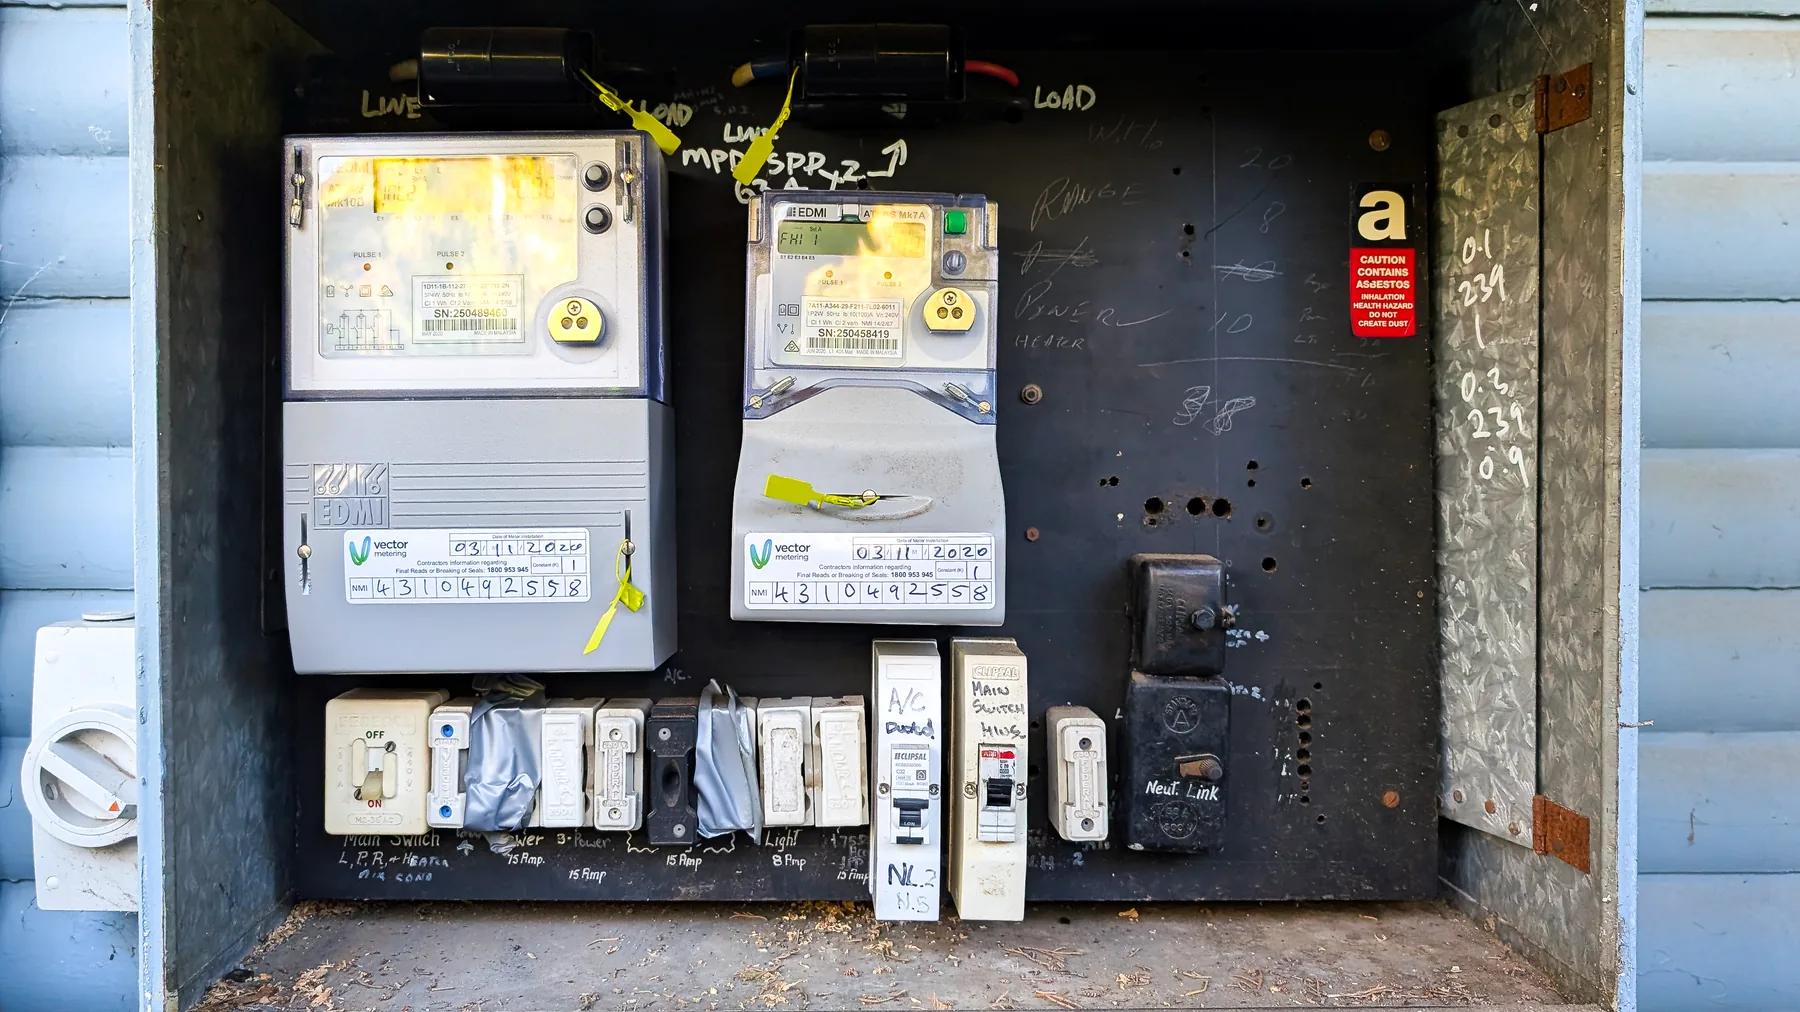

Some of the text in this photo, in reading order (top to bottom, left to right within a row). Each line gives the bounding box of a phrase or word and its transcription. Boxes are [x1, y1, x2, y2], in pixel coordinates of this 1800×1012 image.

[361, 90, 422, 120] LINE
[1034, 86, 1096, 111] LOAD
[798, 207, 827, 218] EDMI
[899, 208, 926, 219] Mk7A
[1357, 190, 1407, 241] a
[1462, 229, 1493, 265] 0.1
[1360, 255, 1406, 265] CAUTION
[1357, 268, 1409, 277] CONTAINS
[1356, 280, 1410, 289] ASBESTOS
[1459, 263, 1506, 307] 239
[1361, 293, 1405, 301] INHALATION
[1353, 302, 1413, 310] HEALTH HAZARD
[434, 309, 507, 318] SN:250489460
[818, 328, 890, 338] SN:250458419
[1467, 401, 1525, 439] 239
[318, 498, 383, 526] EDMI
[373, 540, 408, 550] vector
[775, 543, 811, 553] vector
[374, 550, 407, 558] metering
[974, 666, 1018, 678] CLIPSAL
[972, 700, 1025, 715] SWITCH
[365, 730, 385, 739] OFF
[611, 750, 620, 801] FEDERAL
[1081, 759, 1091, 810] FEDERAL
[1145, 780, 1219, 801] Neut. Link
[368, 800, 382, 808] ON
[765, 829, 803, 852] Light
[678, 852, 702, 871] Amp
[772, 853, 807, 871] 8 Amp
[581, 867, 607, 884] Amp
